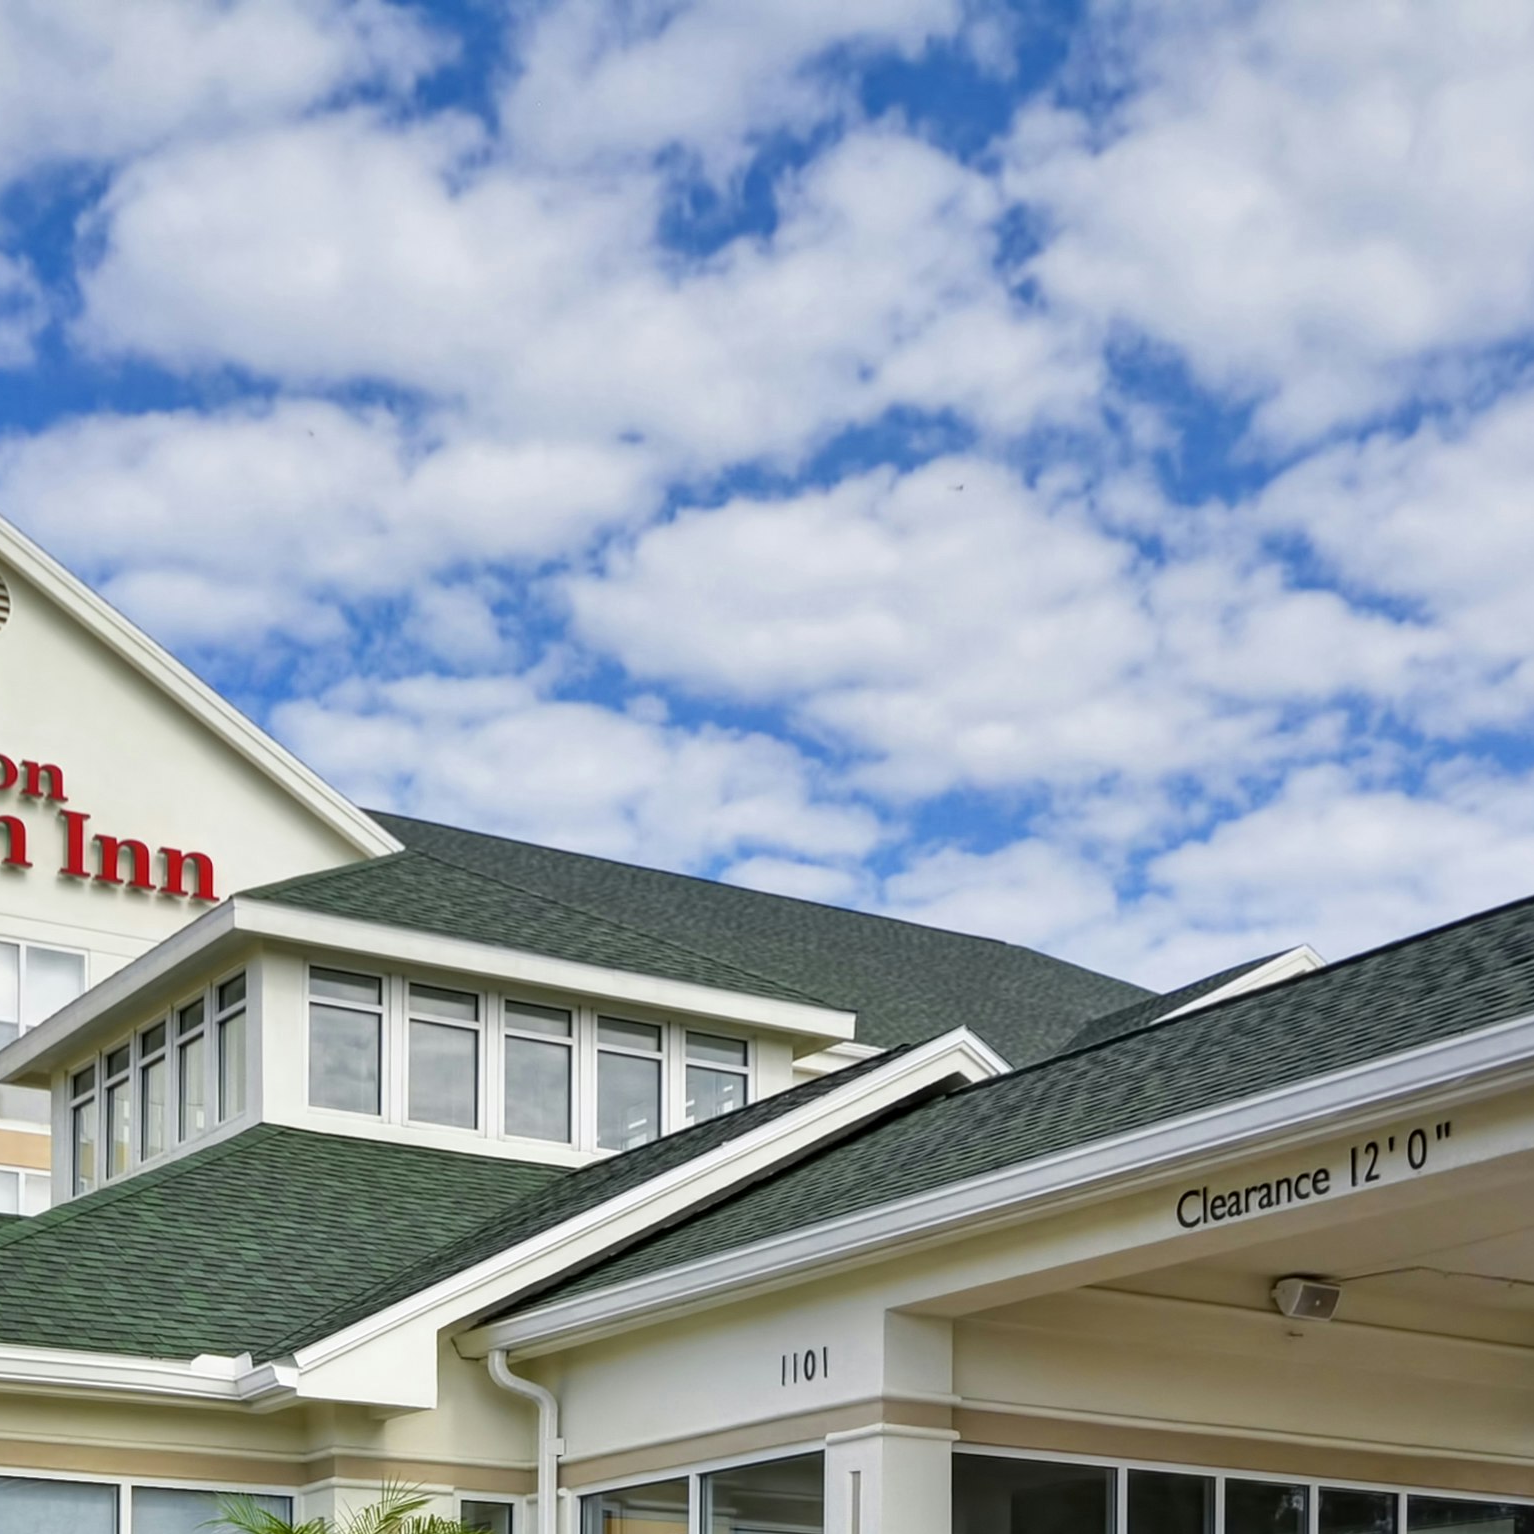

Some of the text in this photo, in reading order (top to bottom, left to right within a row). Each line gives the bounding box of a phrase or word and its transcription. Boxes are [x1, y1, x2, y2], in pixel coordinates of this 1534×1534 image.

[59, 808, 220, 902] Inn
[1176, 1167, 1331, 1228] Clearance
[781, 1346, 828, 1387] 1101
